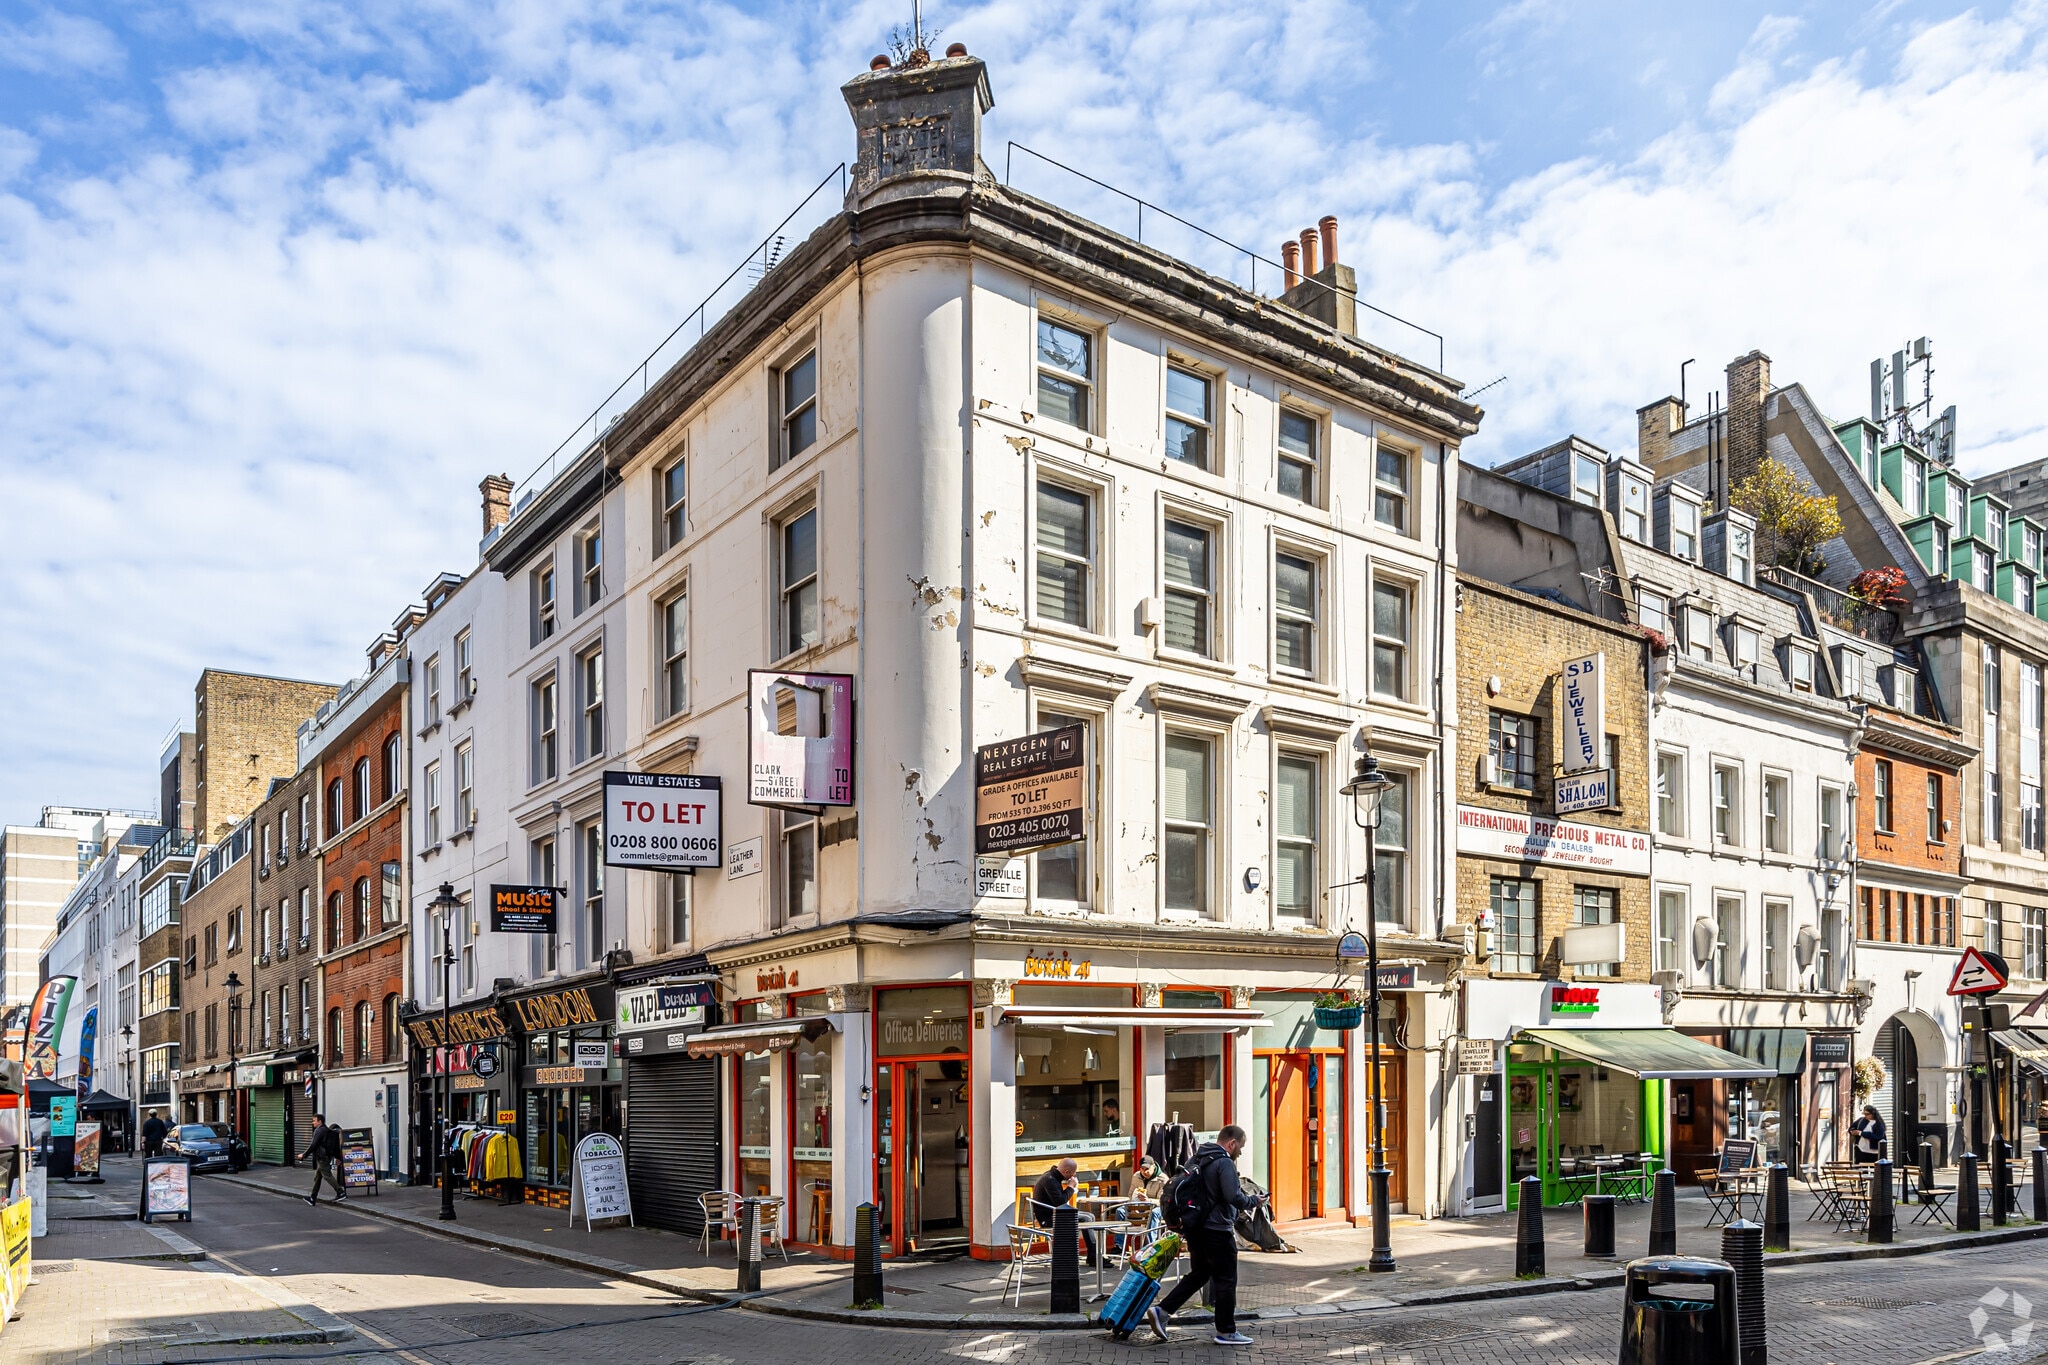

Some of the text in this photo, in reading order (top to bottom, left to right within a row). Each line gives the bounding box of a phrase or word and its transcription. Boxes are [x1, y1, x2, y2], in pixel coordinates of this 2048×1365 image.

[1567, 679, 1594, 764] JEWELLERY
[983, 737, 1048, 760] NEXTGEN
[754, 764, 781, 775] CLARK
[983, 760, 1007, 773] REAL
[1010, 751, 1047, 767] ESTATE
[627, 774, 701, 788] VIEW ESTATES
[768, 776, 800, 787] STREET
[834, 768, 848, 783] TO
[982, 786, 1005, 796] GRADE
[1006, 784, 1012, 792] A
[1012, 778, 1040, 790] OFFICES
[1040, 770, 1078, 785] AVAILABLE
[754, 786, 809, 799] COMMERCIAL
[828, 785, 848, 800] LET
[1011, 788, 1048, 806] TO LET
[1558, 781, 1606, 804] SHALOM
[988, 799, 1072, 821] FROM 535 TO 2,396 SQ FT
[1572, 801, 1585, 809] 405
[622, 801, 706, 825] TO LET
[989, 814, 1069, 839] 0203 405 0070
[1459, 810, 1647, 851] INTERNATIONAL PRECIOUS METAL CO.
[610, 834, 717, 851] 0208 800 0606
[987, 828, 1070, 849] nextgenrealestate.co.uk
[1525, 837, 1593, 853] BULLION DEALERS
[620, 852, 708, 862] commlets@gmail.com
[729, 849, 753, 864] LEATHER
[1503, 844, 1613, 866] SECOND-HAND JEWELLERY BOUGHT
[729, 863, 744, 875] LANE
[979, 868, 1021, 880] GREVILLE
[979, 881, 1024, 894] STREET EC1
[497, 892, 551, 906] MUSIC
[1075, 960, 1091, 979] 41
[788, 970, 799, 987] 41
[1400, 974, 1410, 985] 41
[699, 991, 710, 1003] 41
[515, 988, 597, 1031] LONDON
[27, 982, 66, 1077] PIZZA
[408, 1021, 437, 1048] THE
[885, 1019, 963, 1043] Office Deliveries
[579, 1046, 604, 1054] IQOS
[537, 1067, 583, 1081] CLOBBER
[500, 1113, 514, 1121] £20
[584, 1149, 618, 1157] TOBACCO
[591, 1164, 614, 1172] IQOS
[596, 1205, 620, 1213] RELX
